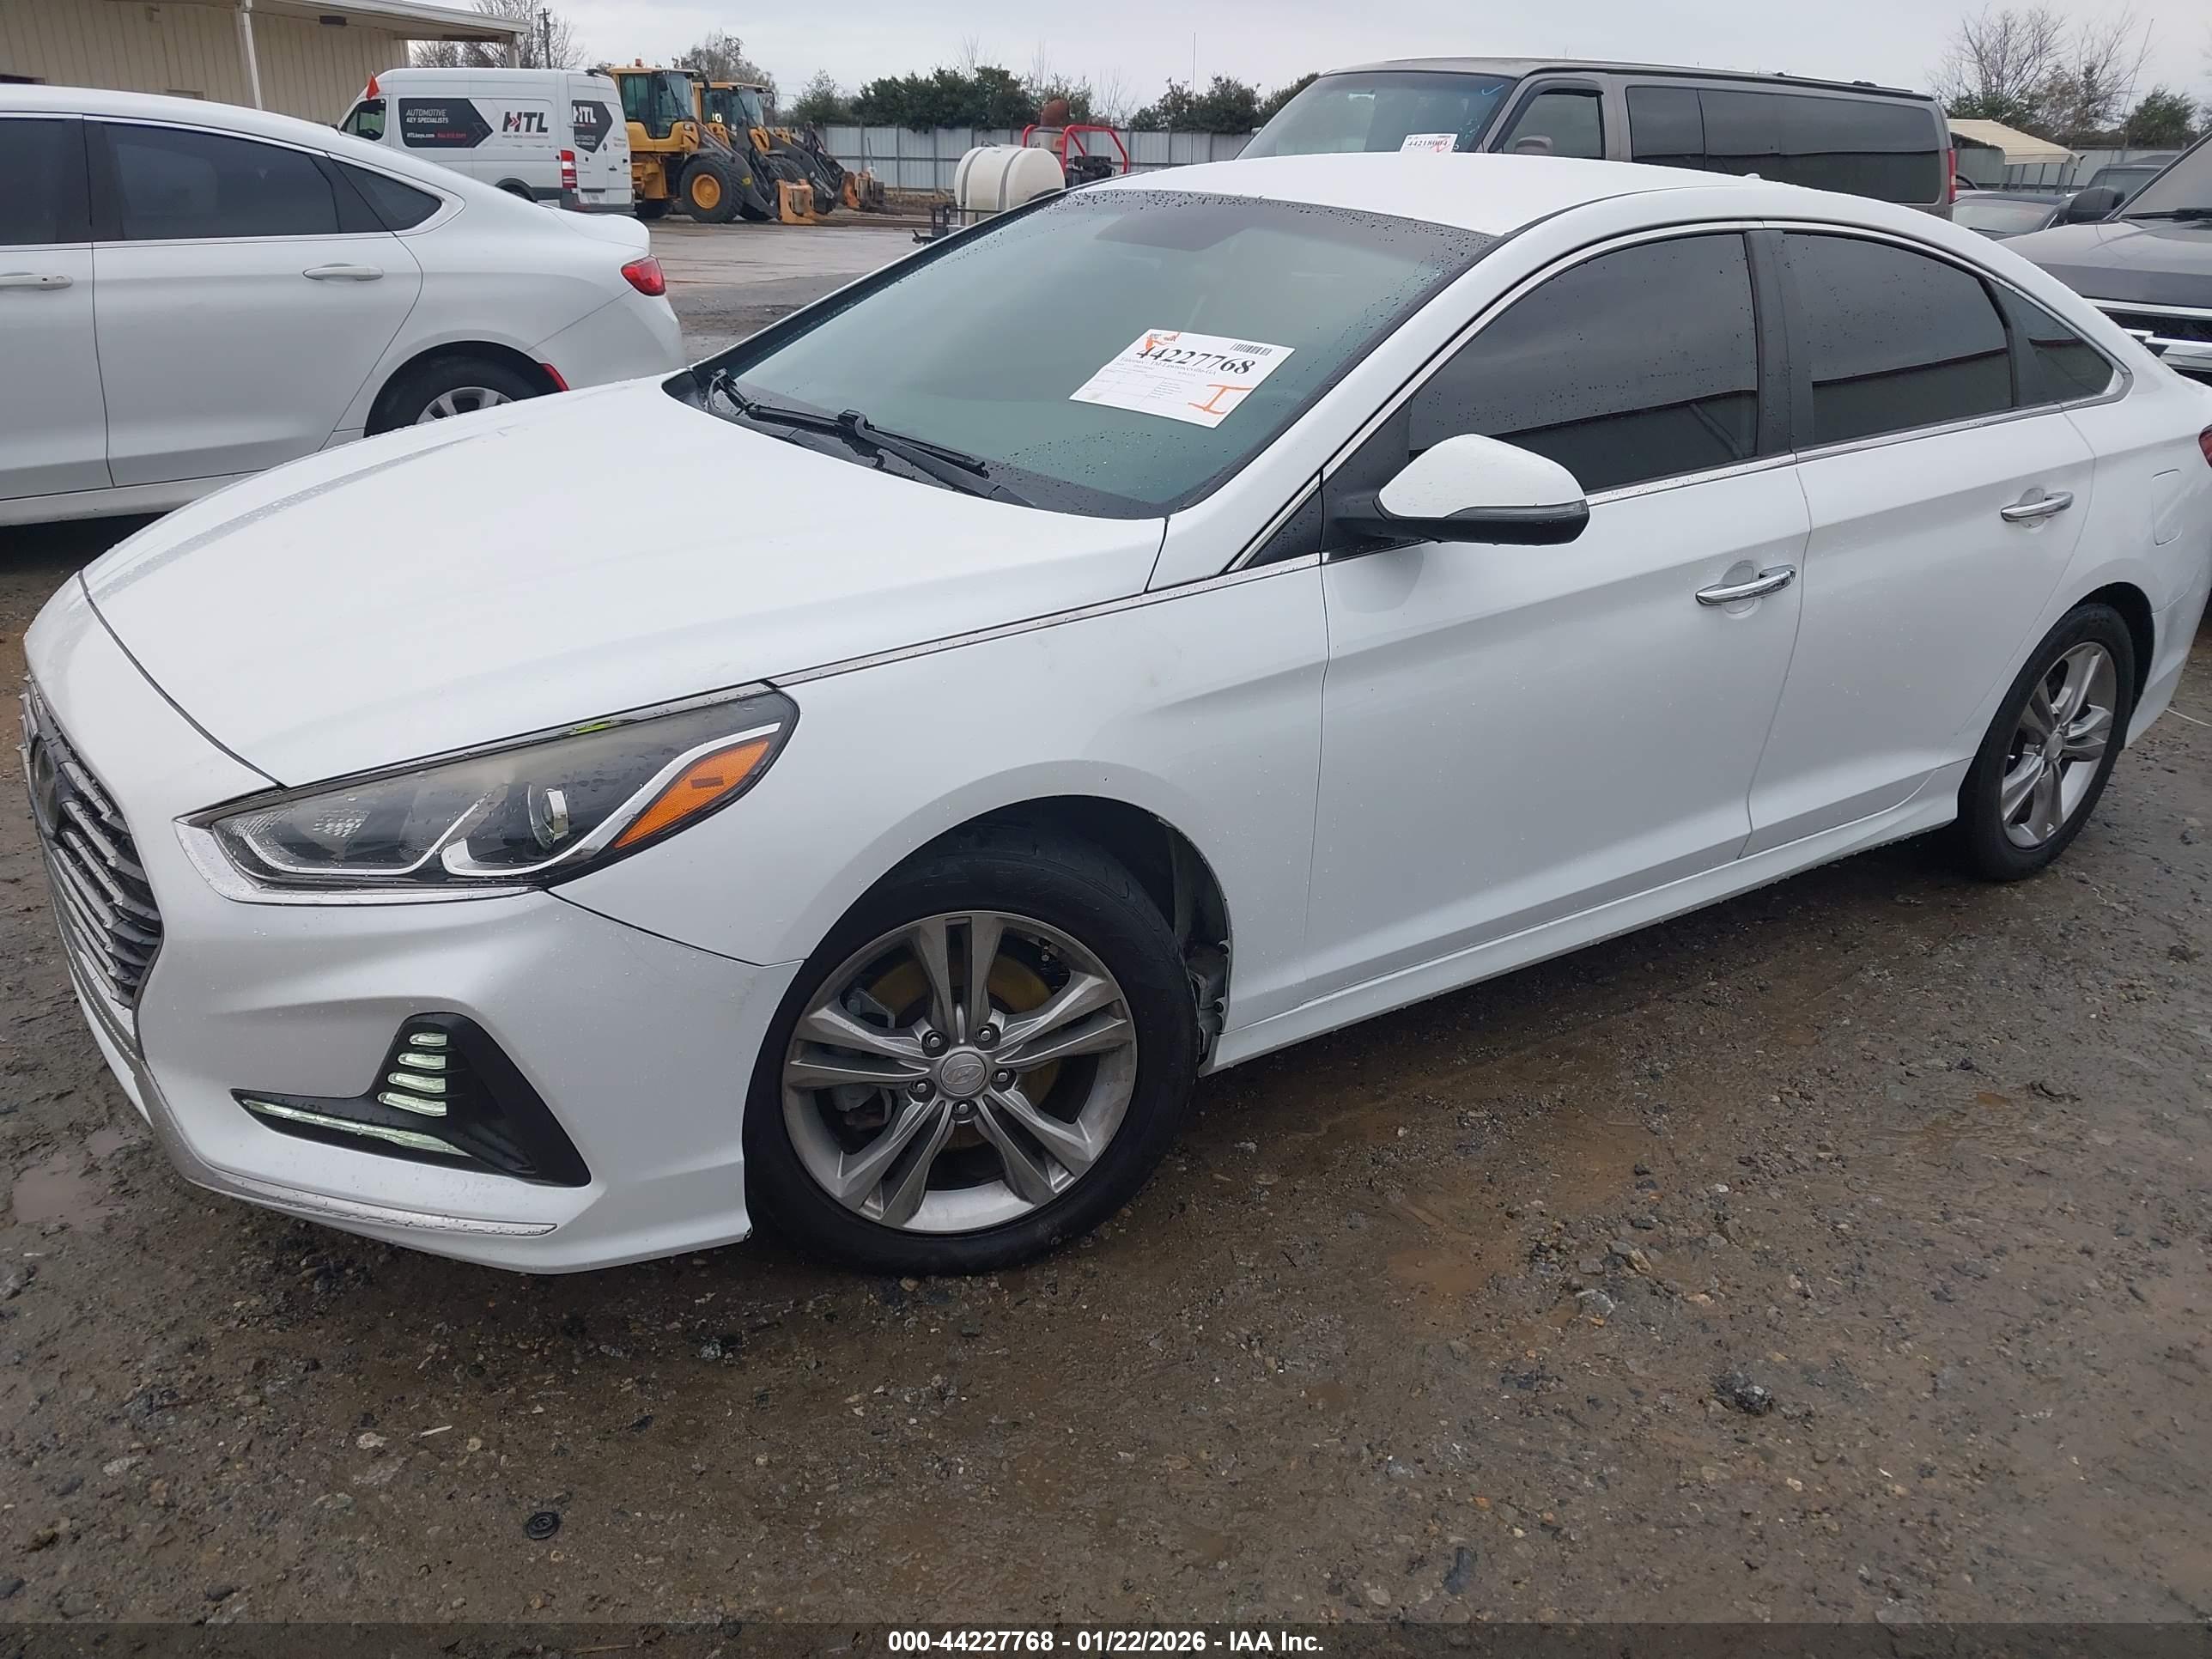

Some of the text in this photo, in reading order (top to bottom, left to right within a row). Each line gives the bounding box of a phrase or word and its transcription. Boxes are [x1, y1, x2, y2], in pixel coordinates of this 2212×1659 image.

[405, 108, 447, 117] AUTOMOTIVE
[502, 111, 549, 132] HTL
[573, 106, 597, 124] HTL
[1136, 346, 1256, 375] 44227768
